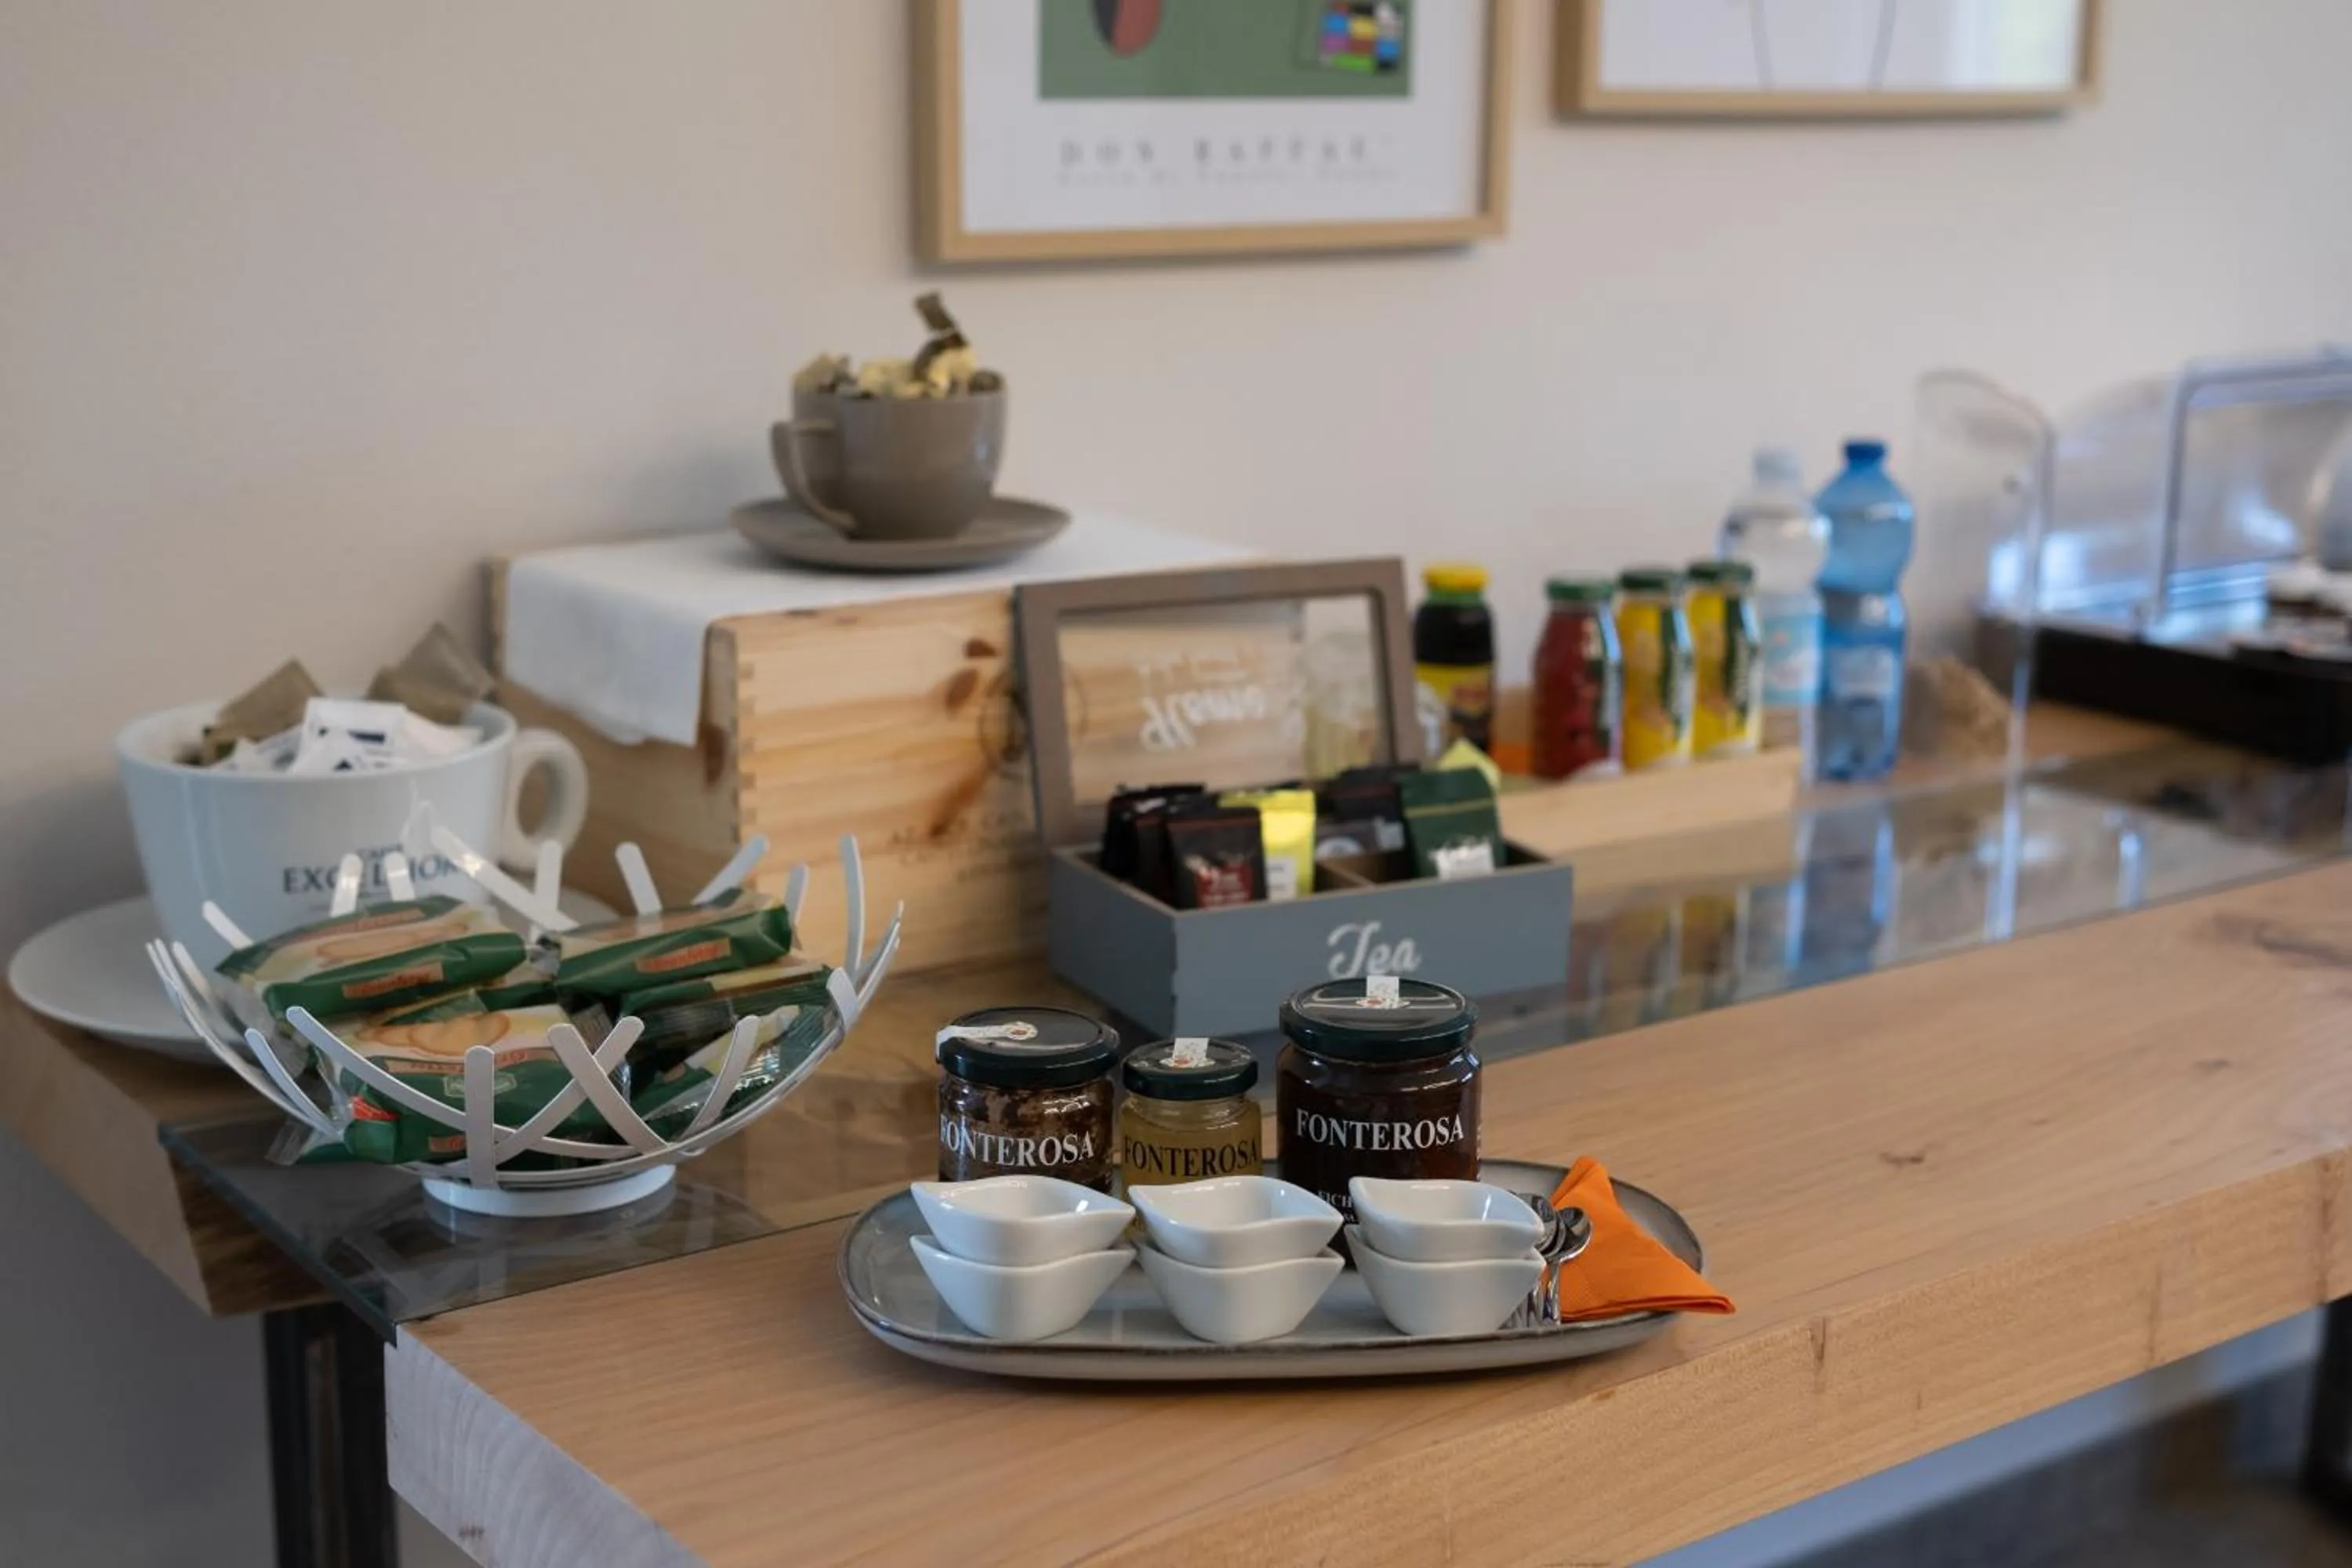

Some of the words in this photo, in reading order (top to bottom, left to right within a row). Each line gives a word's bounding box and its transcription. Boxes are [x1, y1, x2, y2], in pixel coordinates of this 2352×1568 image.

[1327, 920, 1422, 980] Tea
[940, 1113, 1095, 1167] FONTEROSA
[1296, 1108, 1465, 1151] FONTEROSA
[1123, 1134, 1258, 1177] FONTEROSA
